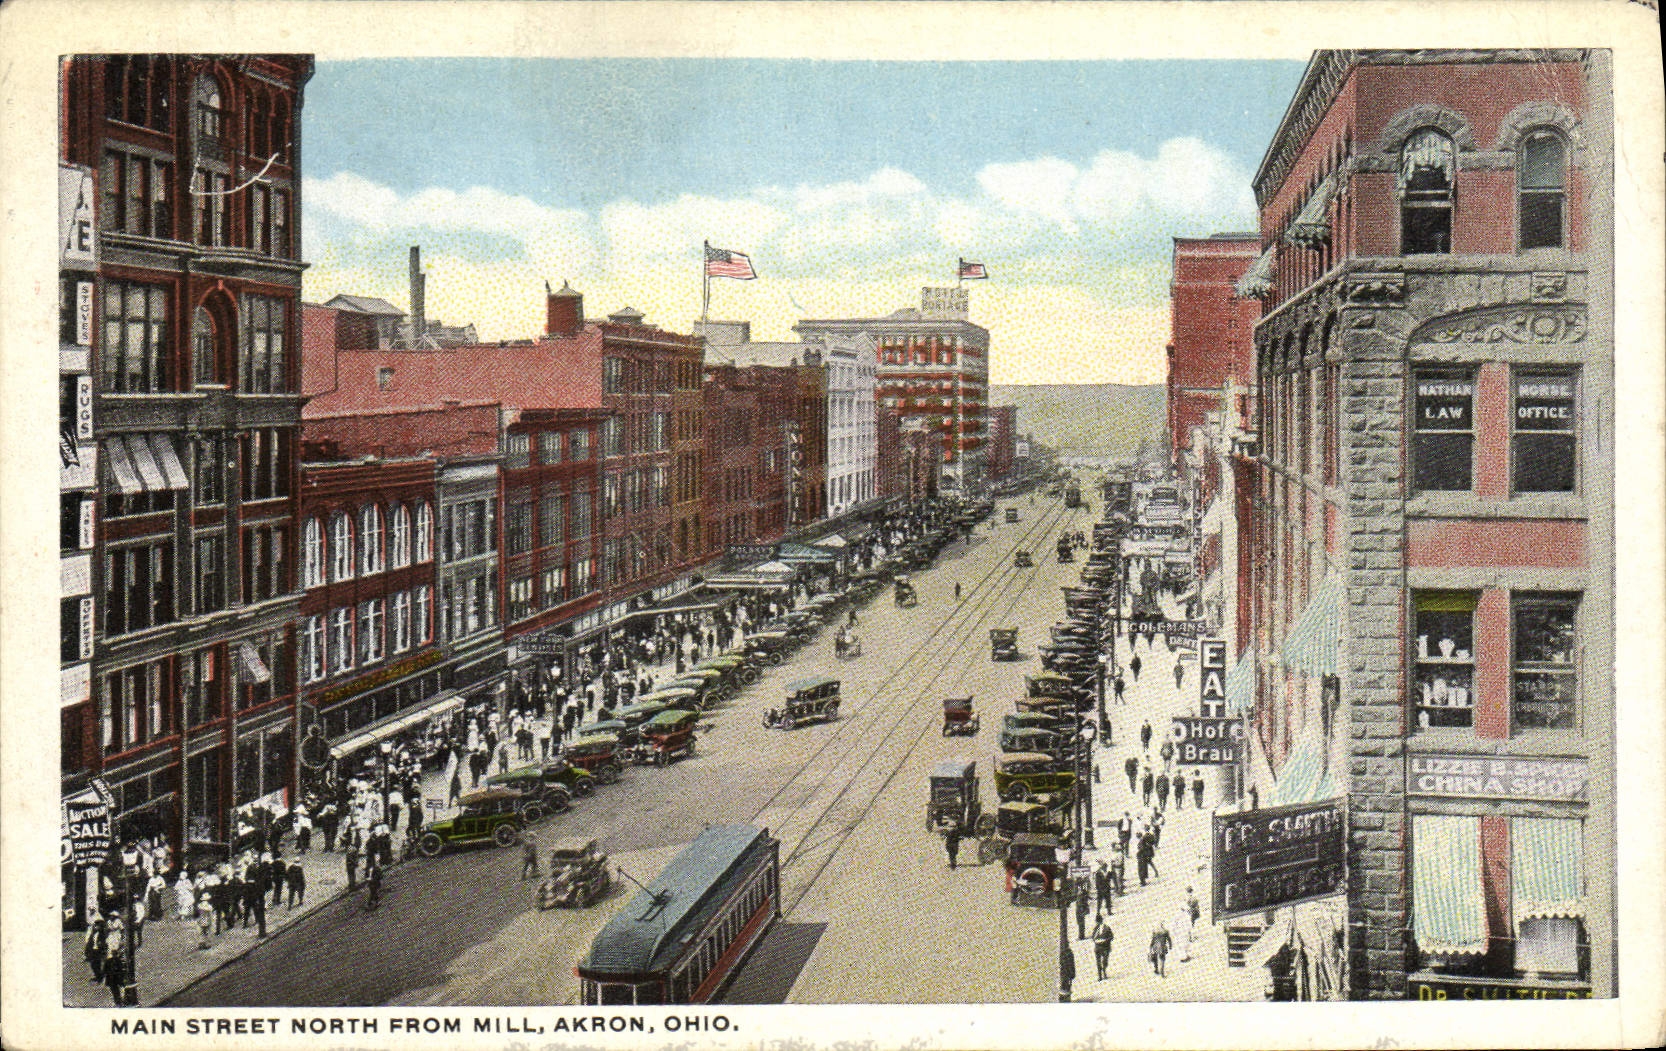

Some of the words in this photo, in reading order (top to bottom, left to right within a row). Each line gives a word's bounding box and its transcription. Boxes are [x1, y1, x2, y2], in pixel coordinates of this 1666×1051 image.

[1419, 384, 1472, 396] NATHAN
[80, 383, 91, 434] RUGS
[1425, 407, 1463, 418] LAW
[1203, 643, 1224, 717] EAT
[1192, 721, 1226, 738] Hof
[1185, 744, 1234, 761] Brau
[1411, 758, 1482, 774] LIZZIE
[1417, 775, 1505, 793] CHINA
[1510, 777, 1583, 795] SHOP
[70, 823, 111, 838] SALE
